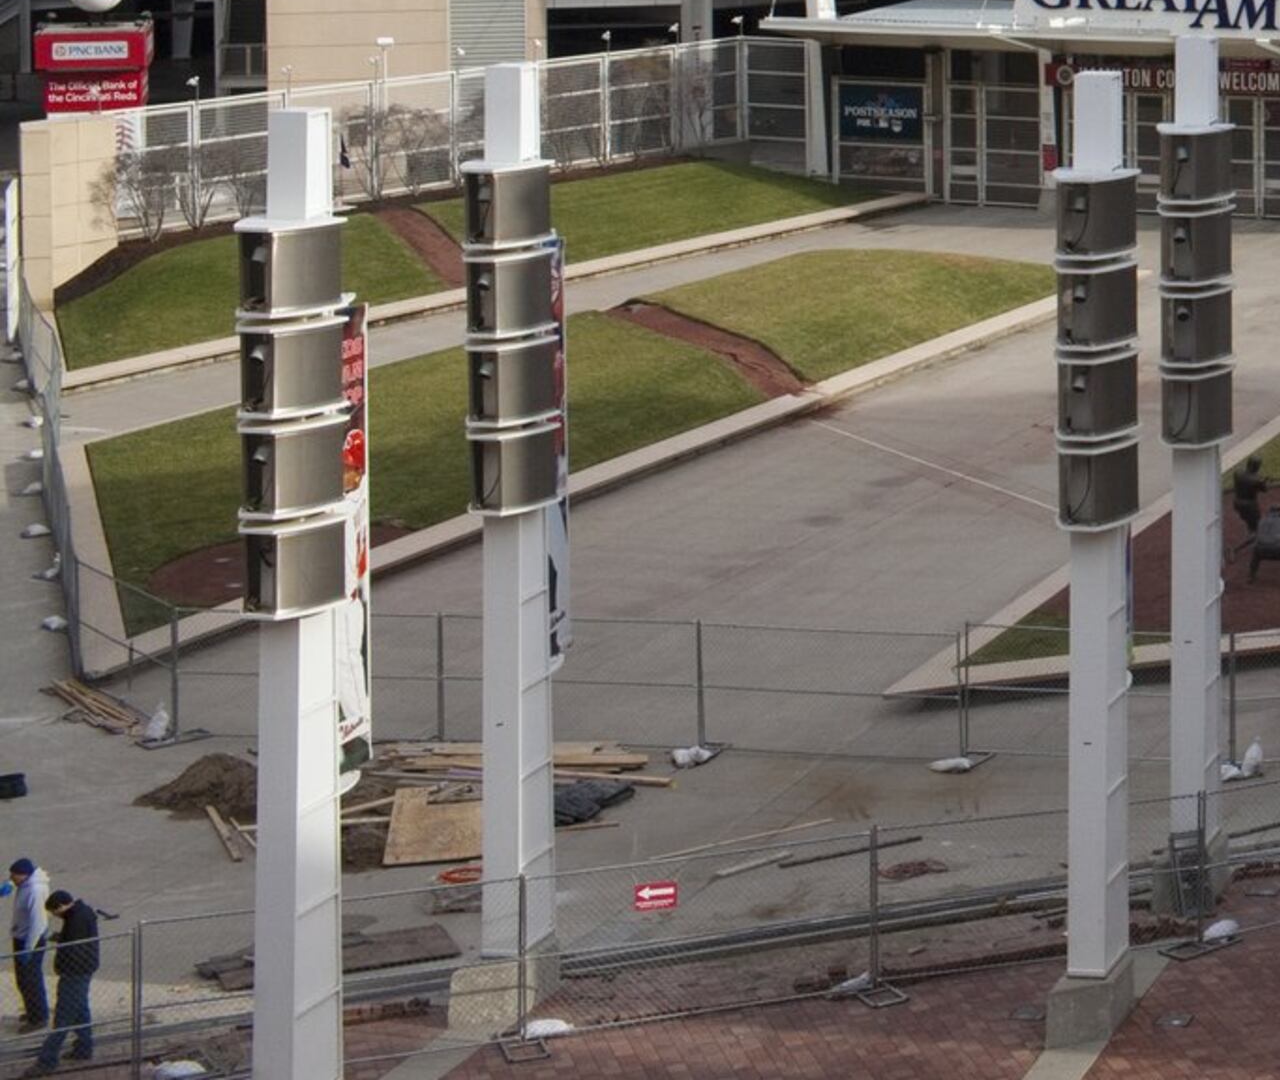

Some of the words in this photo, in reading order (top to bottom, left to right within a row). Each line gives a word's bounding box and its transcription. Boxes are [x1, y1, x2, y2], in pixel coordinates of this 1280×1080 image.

[102, 80, 126, 90] Bank
[128, 80, 138, 89] of
[114, 91, 138, 101] Reds
